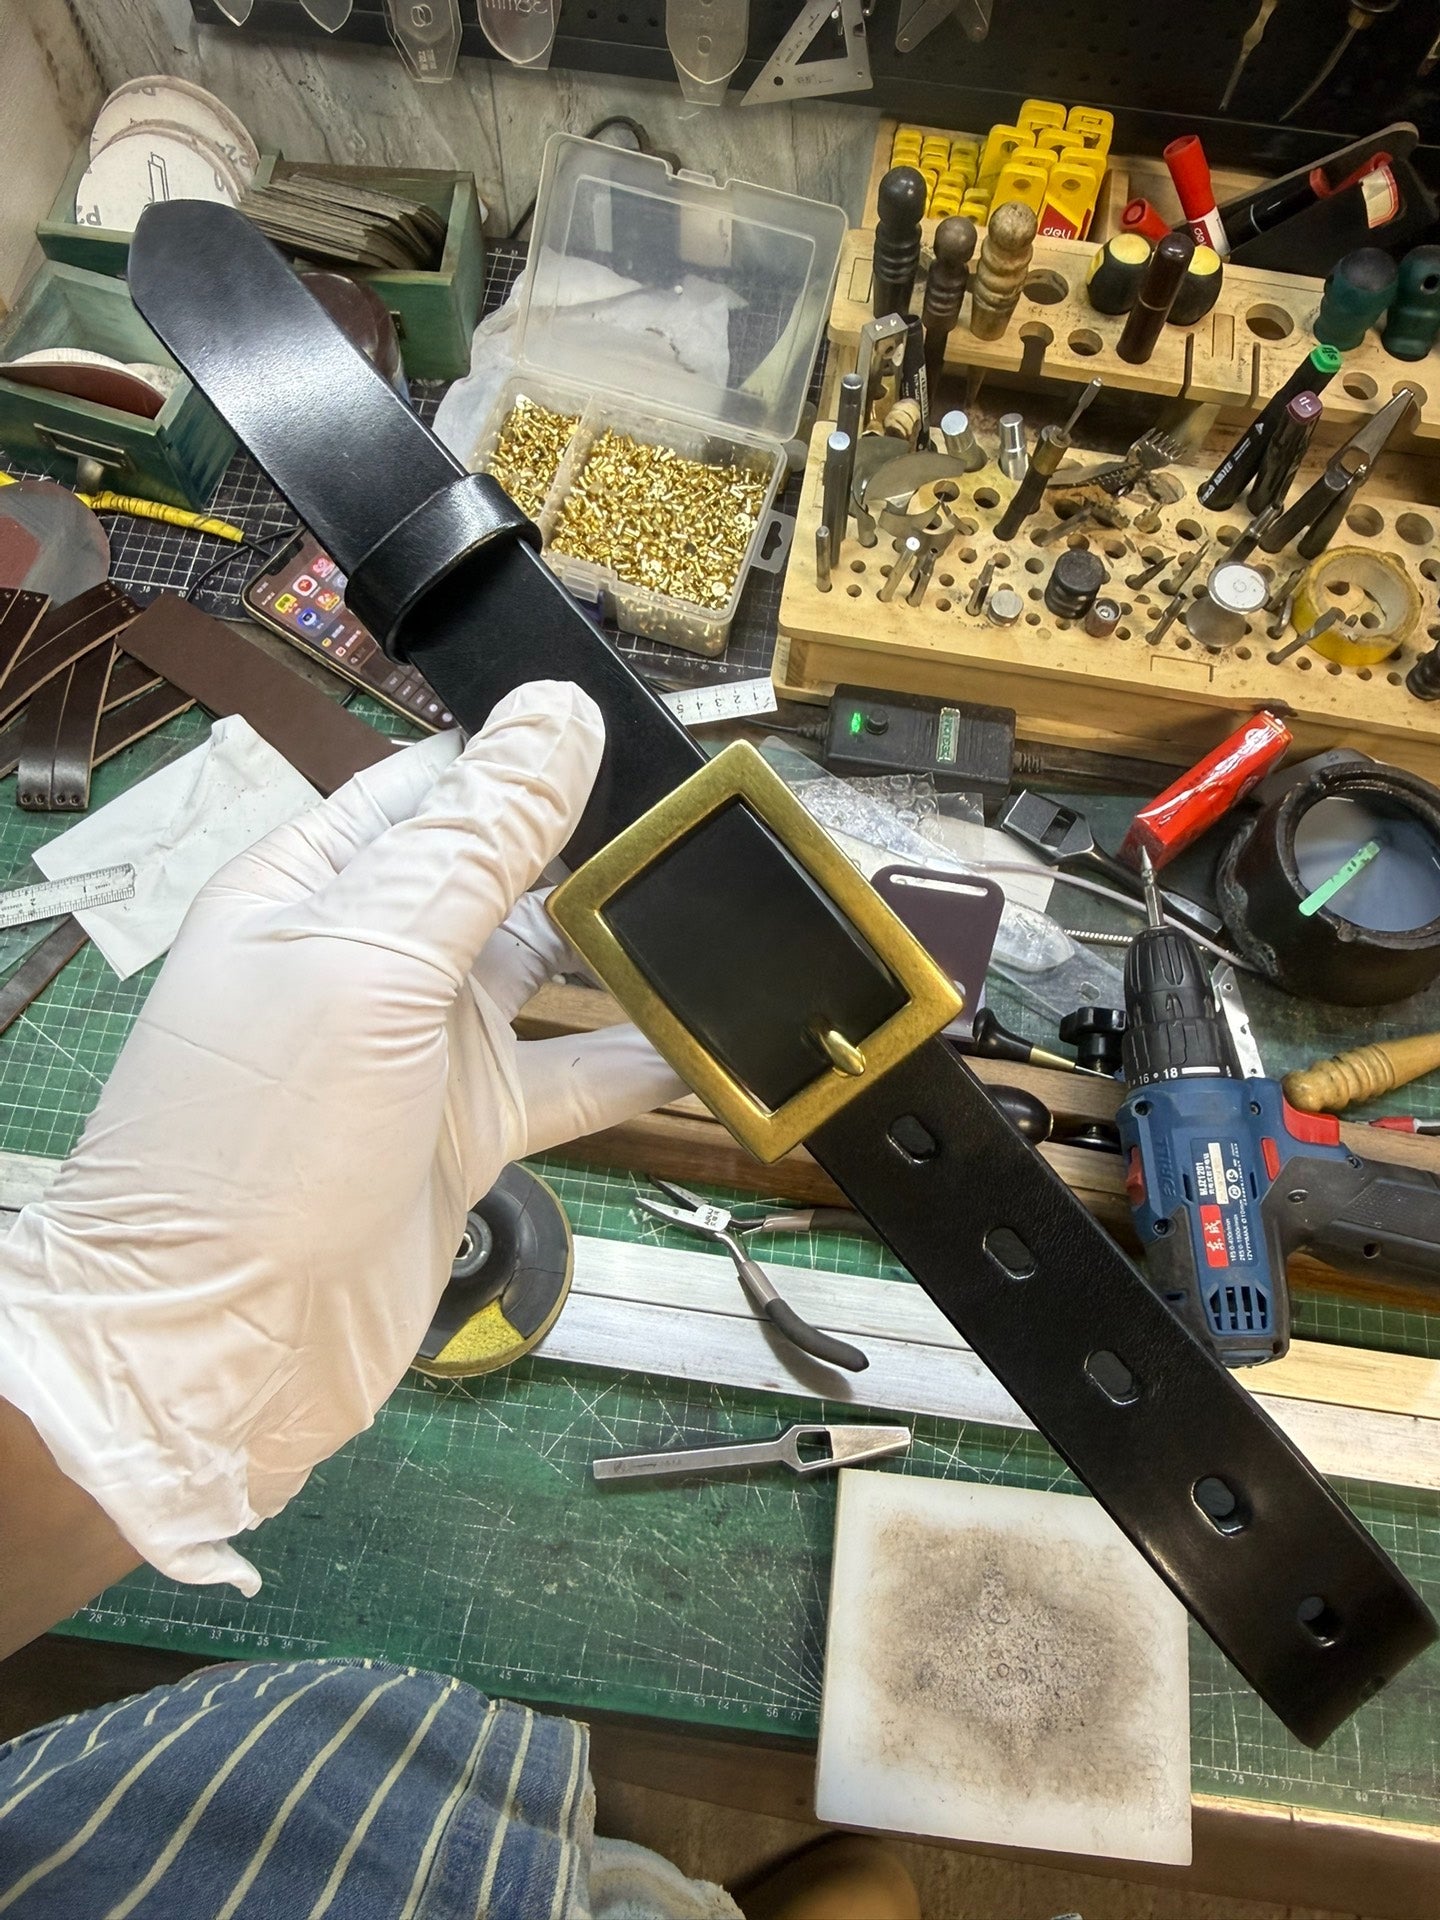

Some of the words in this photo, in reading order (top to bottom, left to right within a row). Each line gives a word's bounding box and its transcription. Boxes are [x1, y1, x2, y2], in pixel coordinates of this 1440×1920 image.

[1043, 226, 1071, 240] deli
[714, 698, 722, 707] 3
[733, 695, 741, 704] 2
[676, 704, 684, 714] 5
[1139, 1073, 1149, 1084] 16
[1163, 1067, 1178, 1079] 18
[1205, 1219, 1225, 1252] 东成
[89, 1612, 102, 1623] 28
[113, 1616, 126, 1626] 29
[767, 1707, 779, 1718] 56
